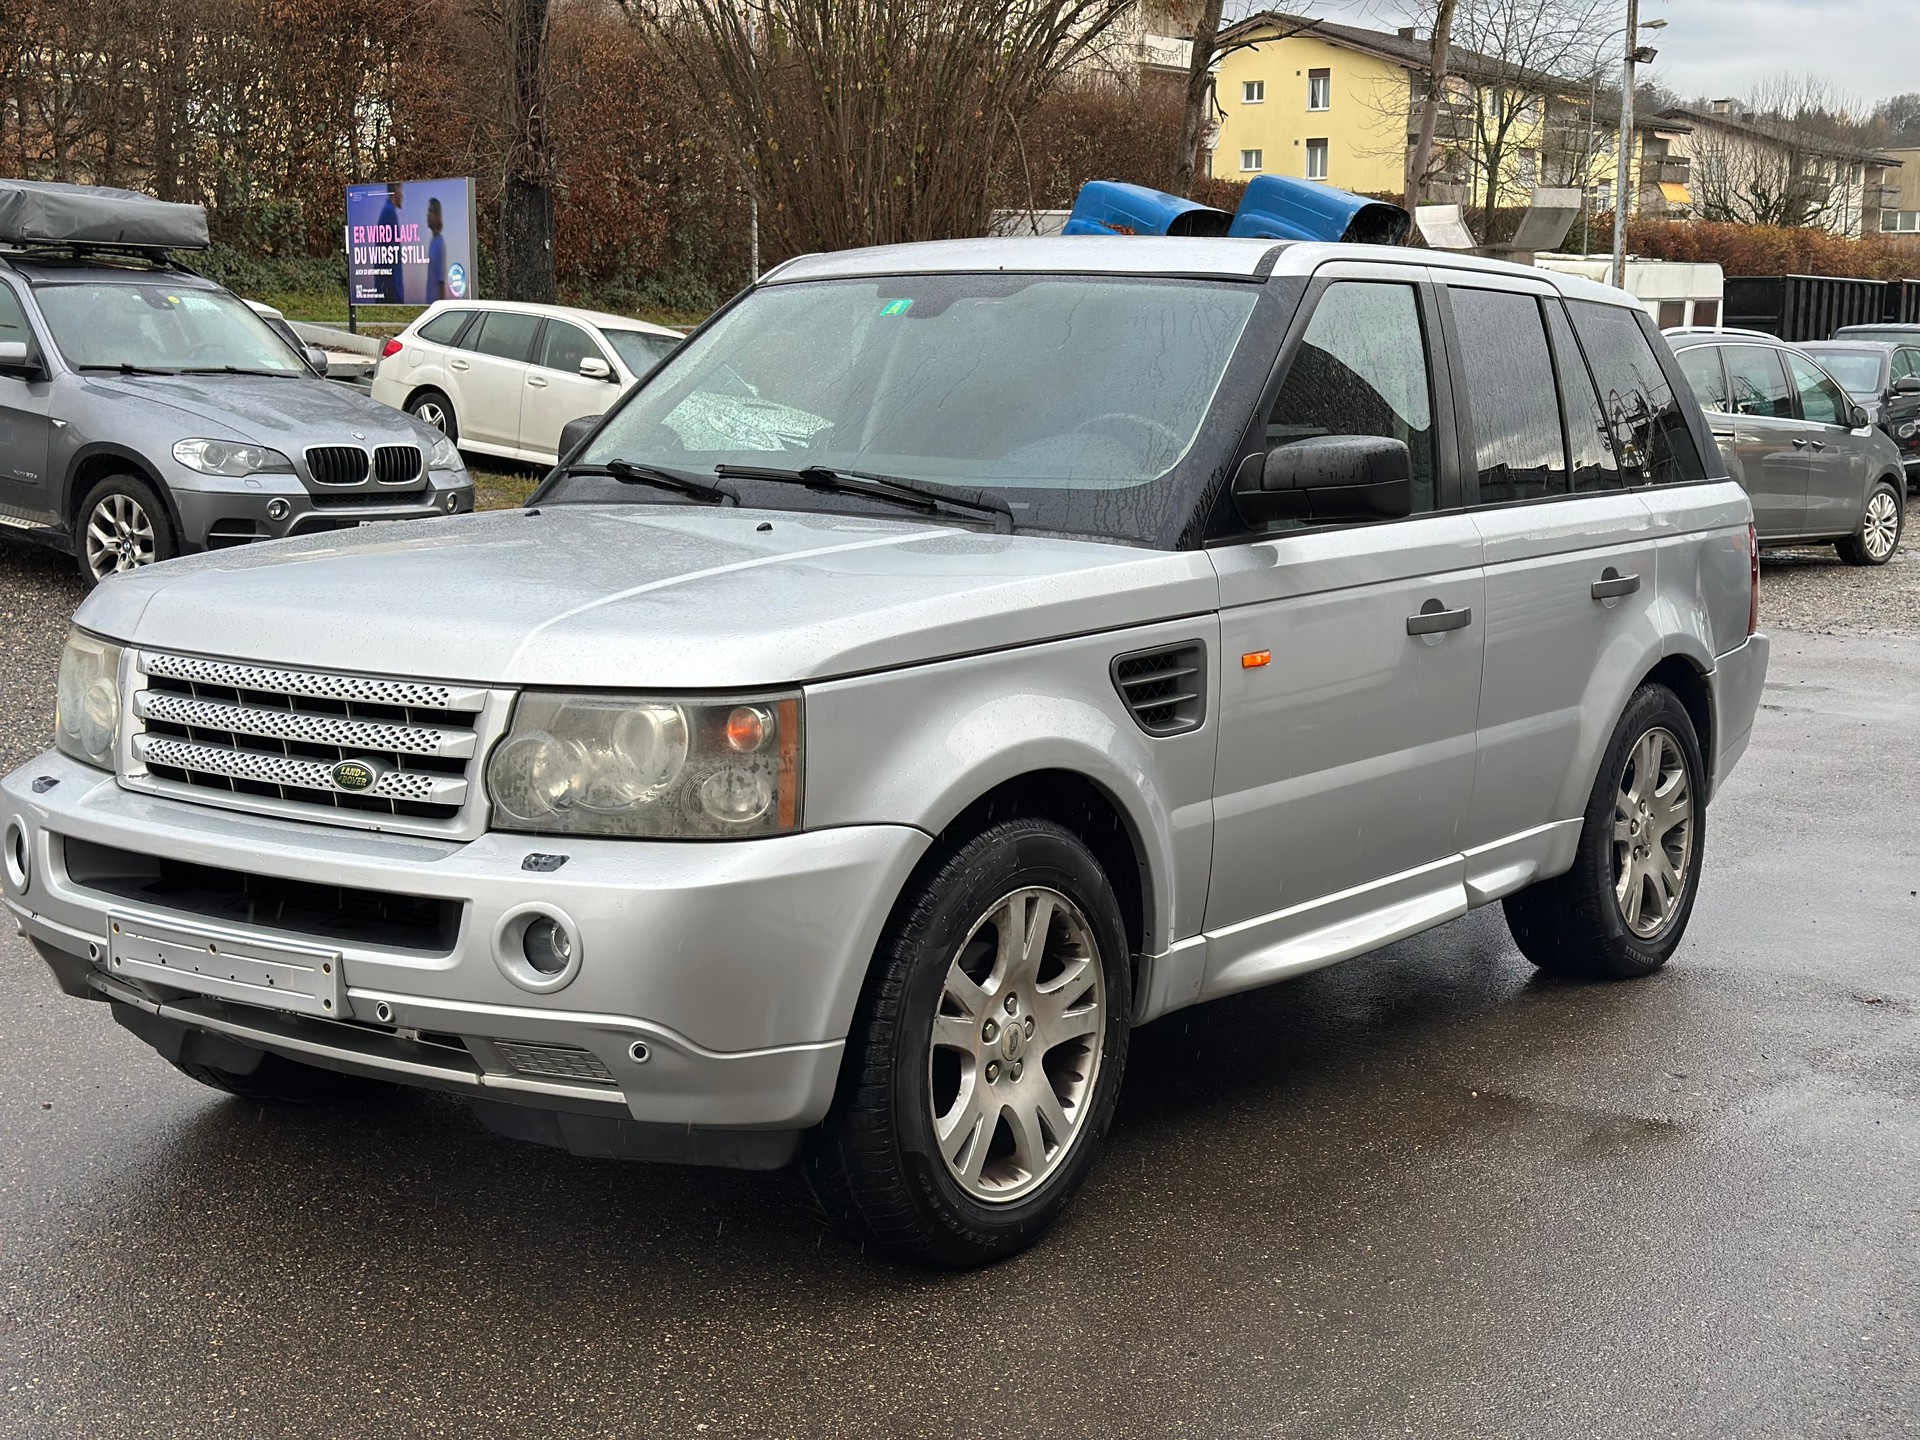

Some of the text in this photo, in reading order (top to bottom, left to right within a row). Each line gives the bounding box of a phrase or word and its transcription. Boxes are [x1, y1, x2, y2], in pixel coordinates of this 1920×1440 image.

[353, 223, 420, 243] ER WIRD LAUT.
[354, 244, 430, 265] DU WIRST STILL.
[340, 766, 361, 777] LAND
[341, 776, 367, 786] ROVER
